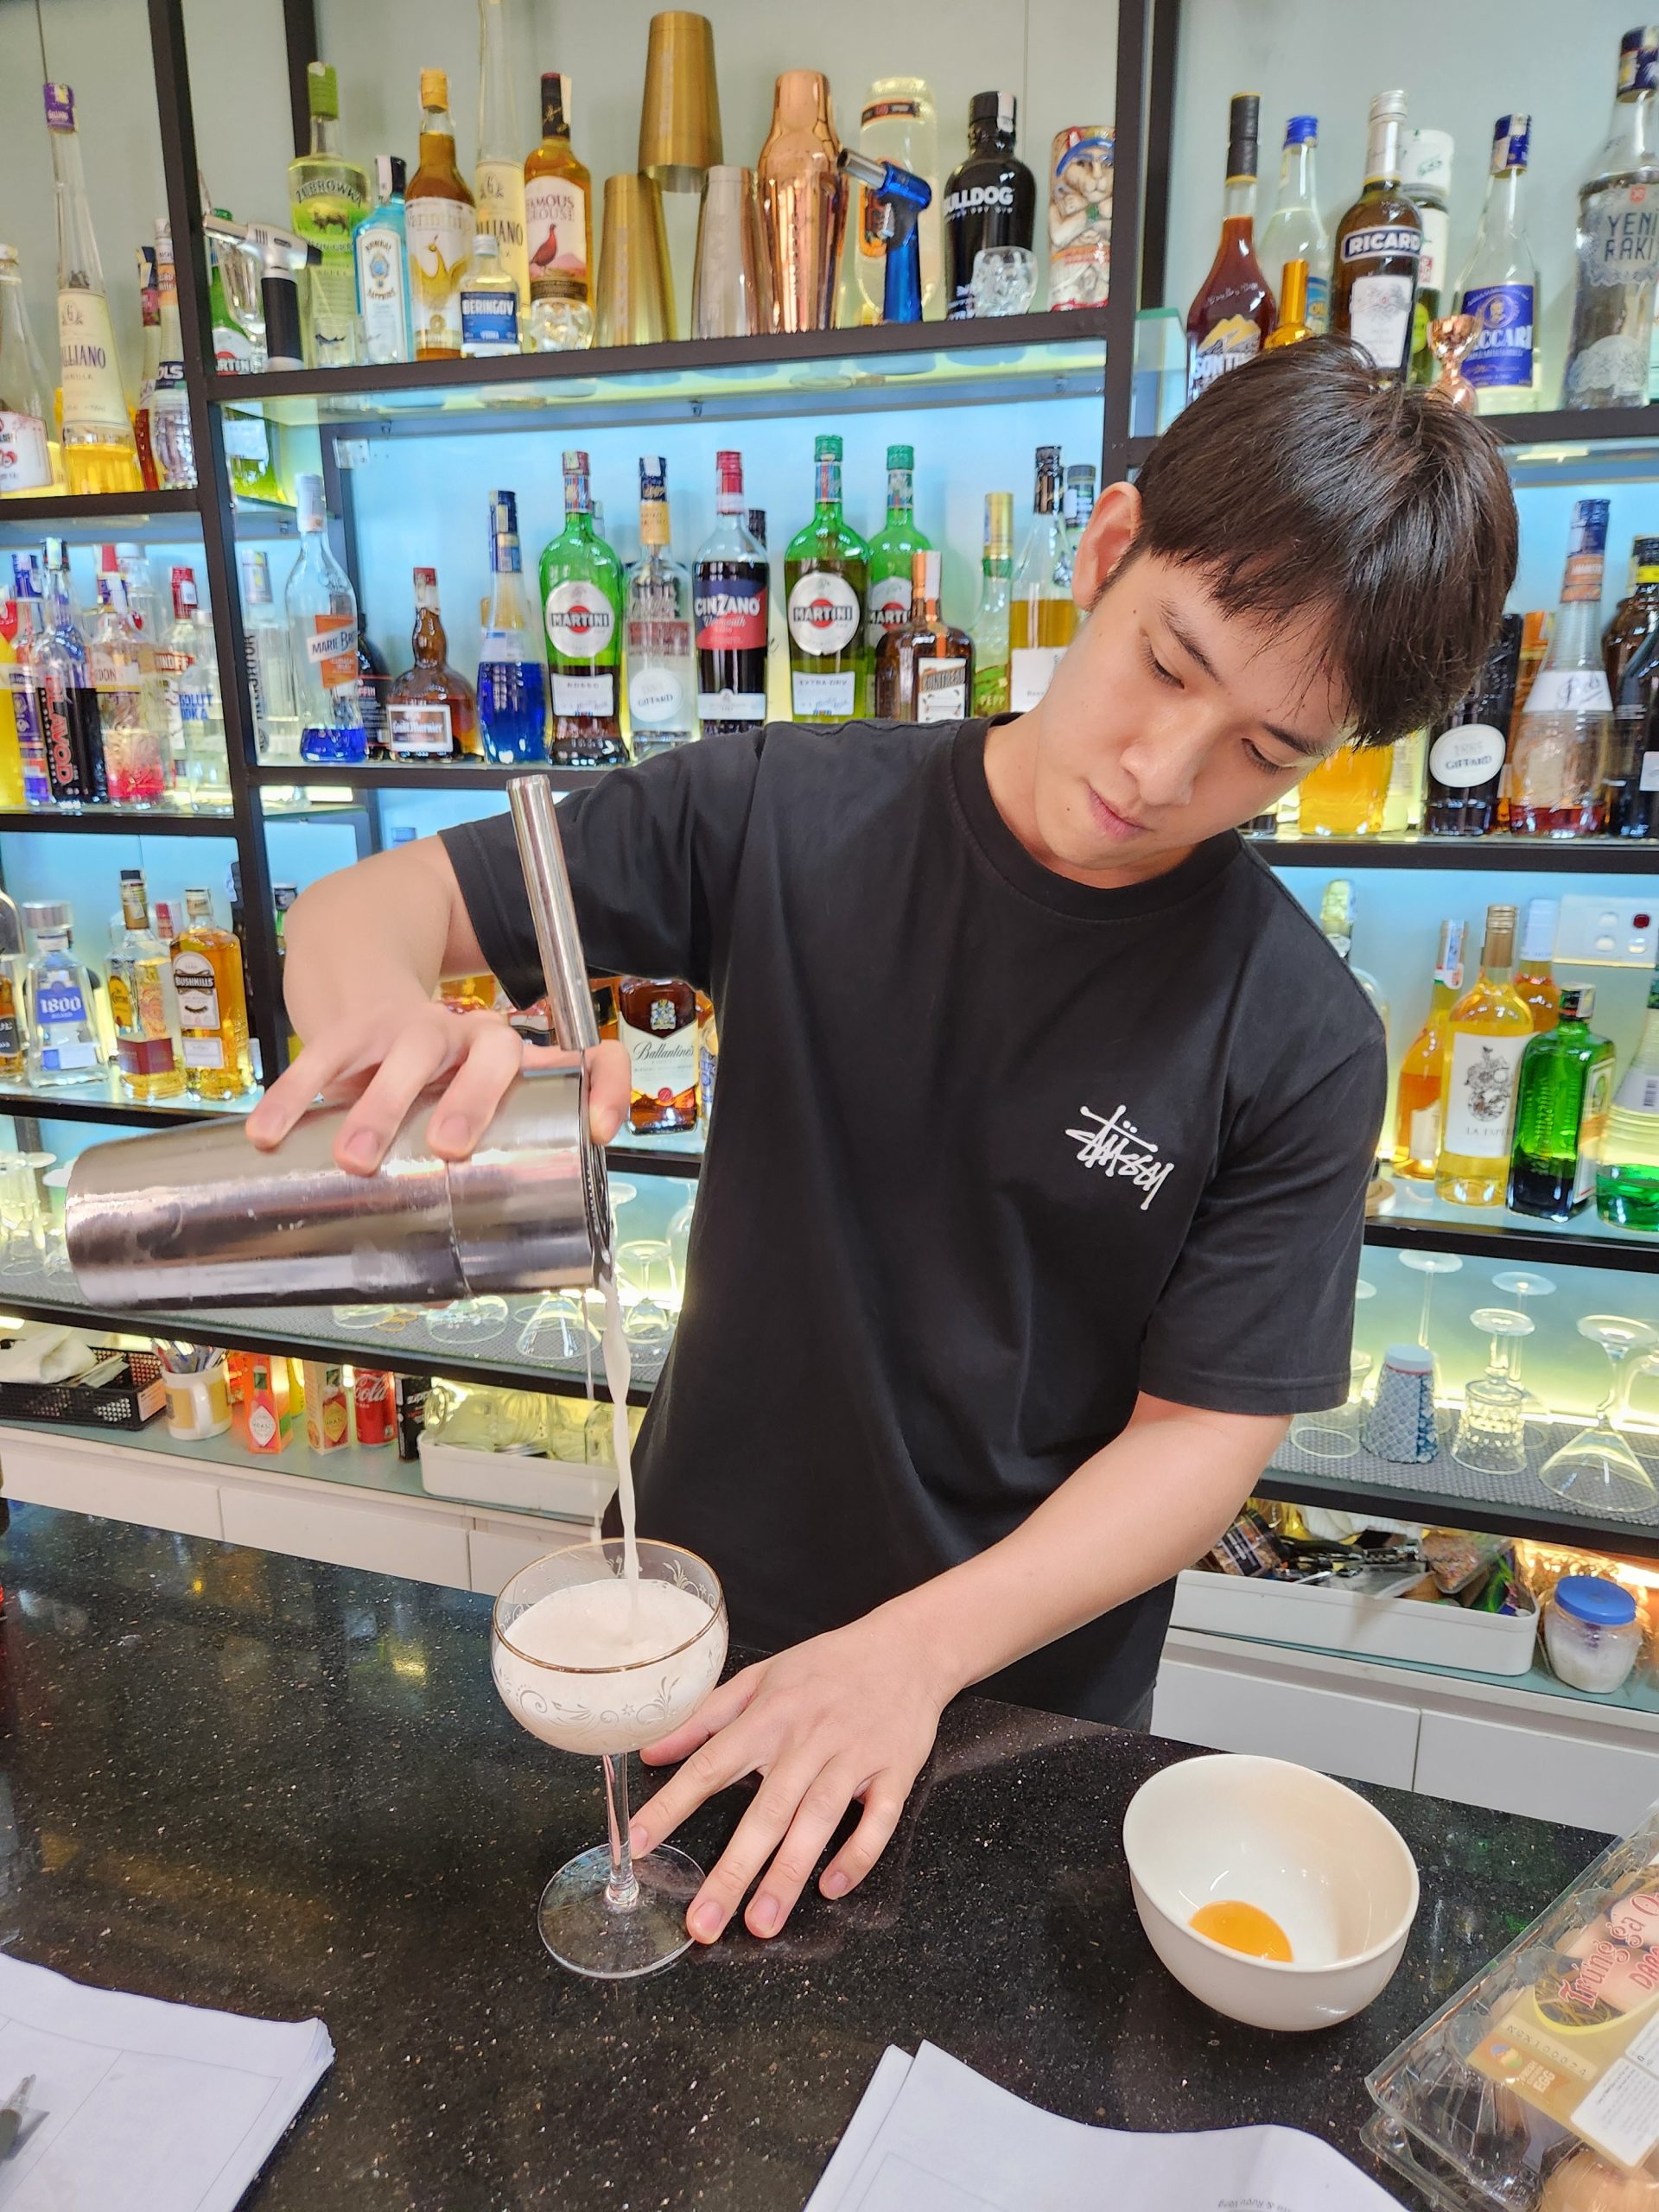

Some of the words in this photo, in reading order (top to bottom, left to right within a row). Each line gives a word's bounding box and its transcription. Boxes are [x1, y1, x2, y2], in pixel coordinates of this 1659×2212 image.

[1349, 232, 1421, 255] RICARD
[461, 300, 514, 316] BERINGOV
[695, 594, 760, 617] CINZANO
[552, 612, 609, 628] MARTINI
[793, 607, 853, 622] MARTINI
[175, 976, 214, 988] BUSHMILLS
[41, 995, 82, 1014] 1800
